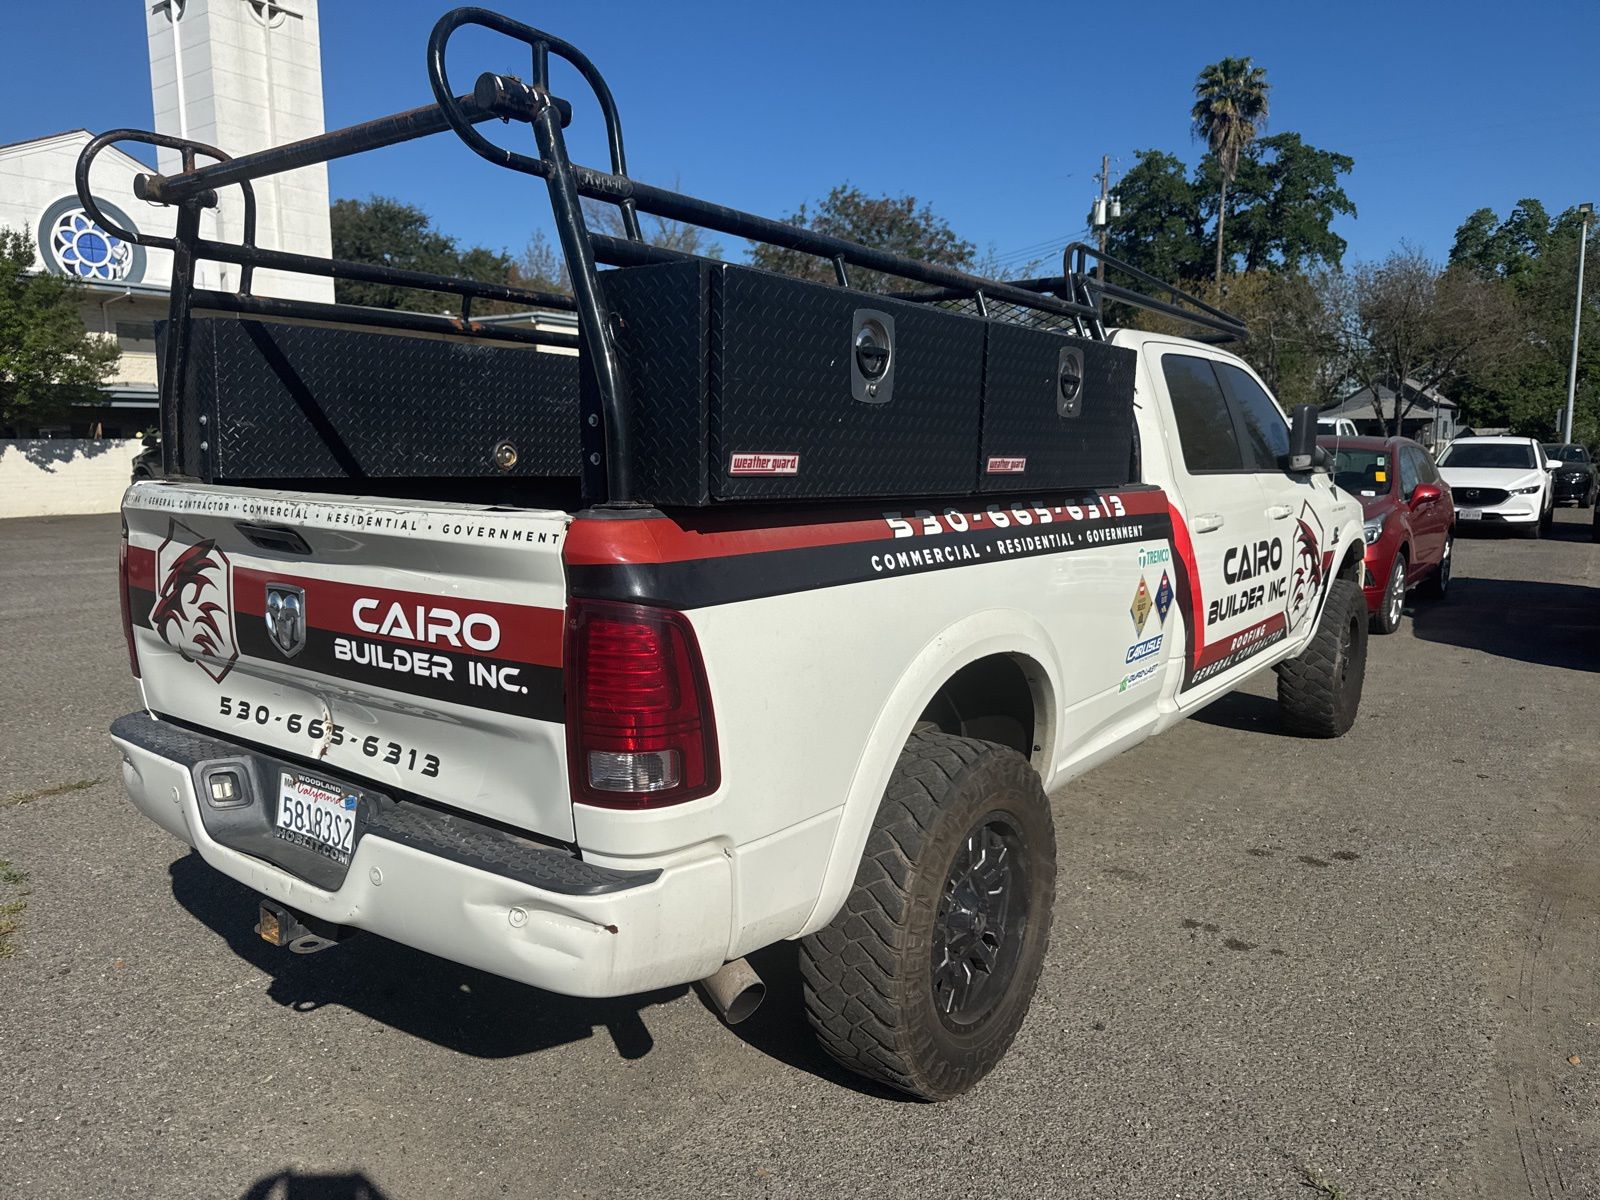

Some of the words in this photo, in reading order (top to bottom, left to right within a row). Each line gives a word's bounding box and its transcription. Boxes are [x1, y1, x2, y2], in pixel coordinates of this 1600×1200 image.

[733, 455, 770, 469] weather
[771, 456, 797, 471] guard
[148, 496, 175, 508] GENERAL
[179, 500, 229, 512] CONTRACTOR
[243, 504, 308, 520] COMMERCIAL
[327, 512, 417, 531] RESIDENTIAL
[442, 524, 559, 544] GOVERNMENT
[882, 495, 1126, 539] 530-665-6313
[871, 543, 980, 572] COMMERCIAL
[996, 532, 1075, 555] RESIDENTIAL
[1086, 524, 1143, 543] GOVERNMENT
[1147, 549, 1169, 565] TREMCO
[1223, 537, 1282, 585] CAIRO
[352, 597, 501, 652] CAIRO
[1207, 584, 1264, 626] BUILDER
[1268, 576, 1286, 602] INC.
[1192, 653, 1233, 684] GENERAL
[1235, 628, 1284, 662] CONTRACTOR
[1230, 624, 1266, 651] ROOFING
[334, 637, 454, 682] BUILDER
[468, 661, 529, 695] INC.
[219, 696, 441, 778] 530-665-6313
[297, 782, 341, 804] California
[298, 774, 341, 793] WOODLAND
[283, 796, 352, 852] 58183S2
